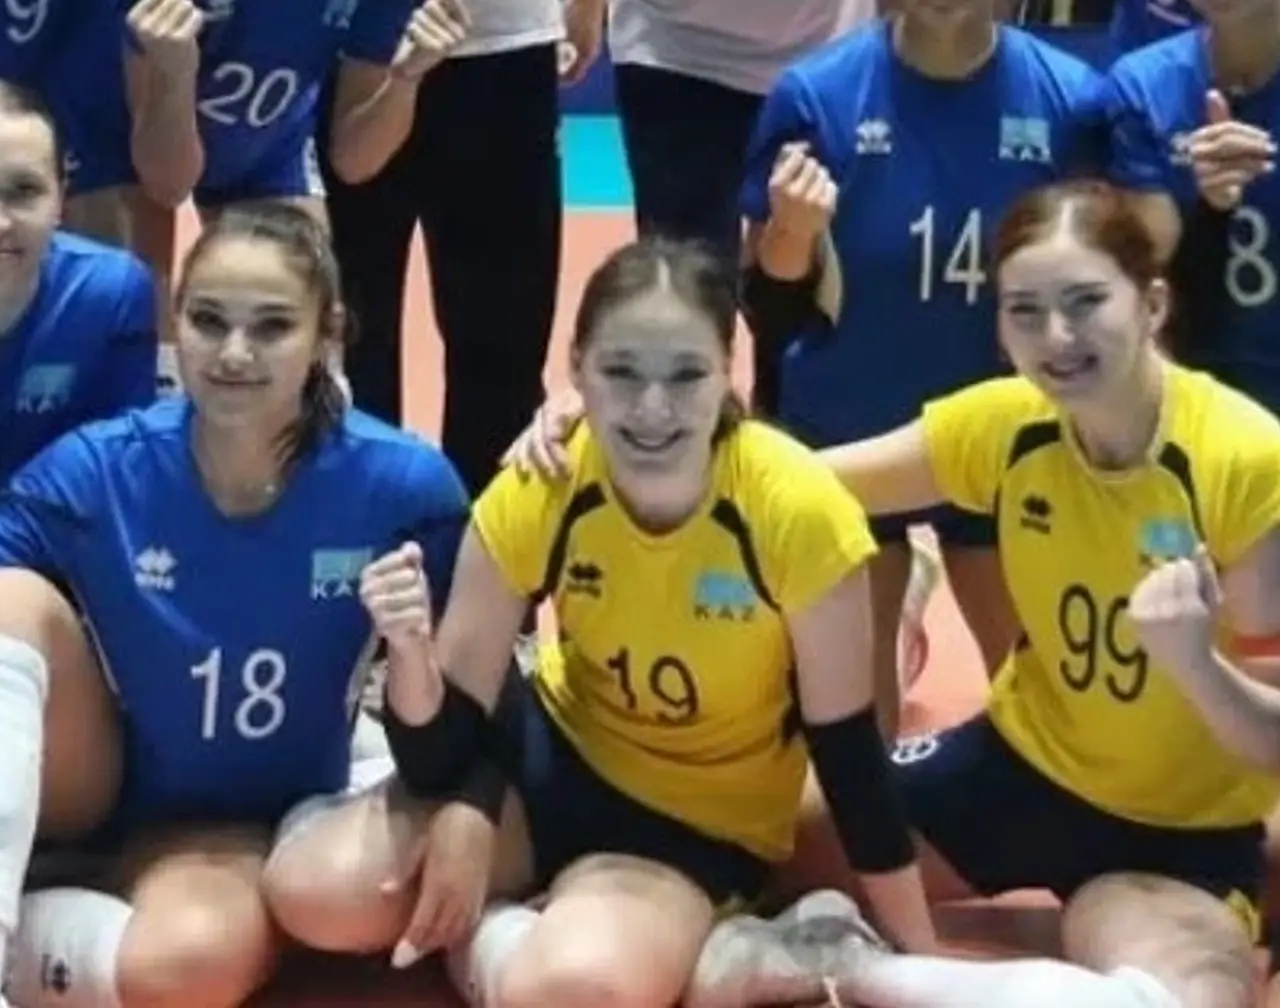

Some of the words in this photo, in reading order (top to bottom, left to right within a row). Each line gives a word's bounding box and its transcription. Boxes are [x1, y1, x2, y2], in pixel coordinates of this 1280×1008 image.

[198, 62, 297, 128] 20
[910, 205, 987, 306] 14
[1225, 206, 1277, 307] 8
[692, 603, 757, 622] KAZ
[1058, 584, 1148, 703] 99
[189, 647, 287, 740] 18
[607, 647, 698, 728] 19
